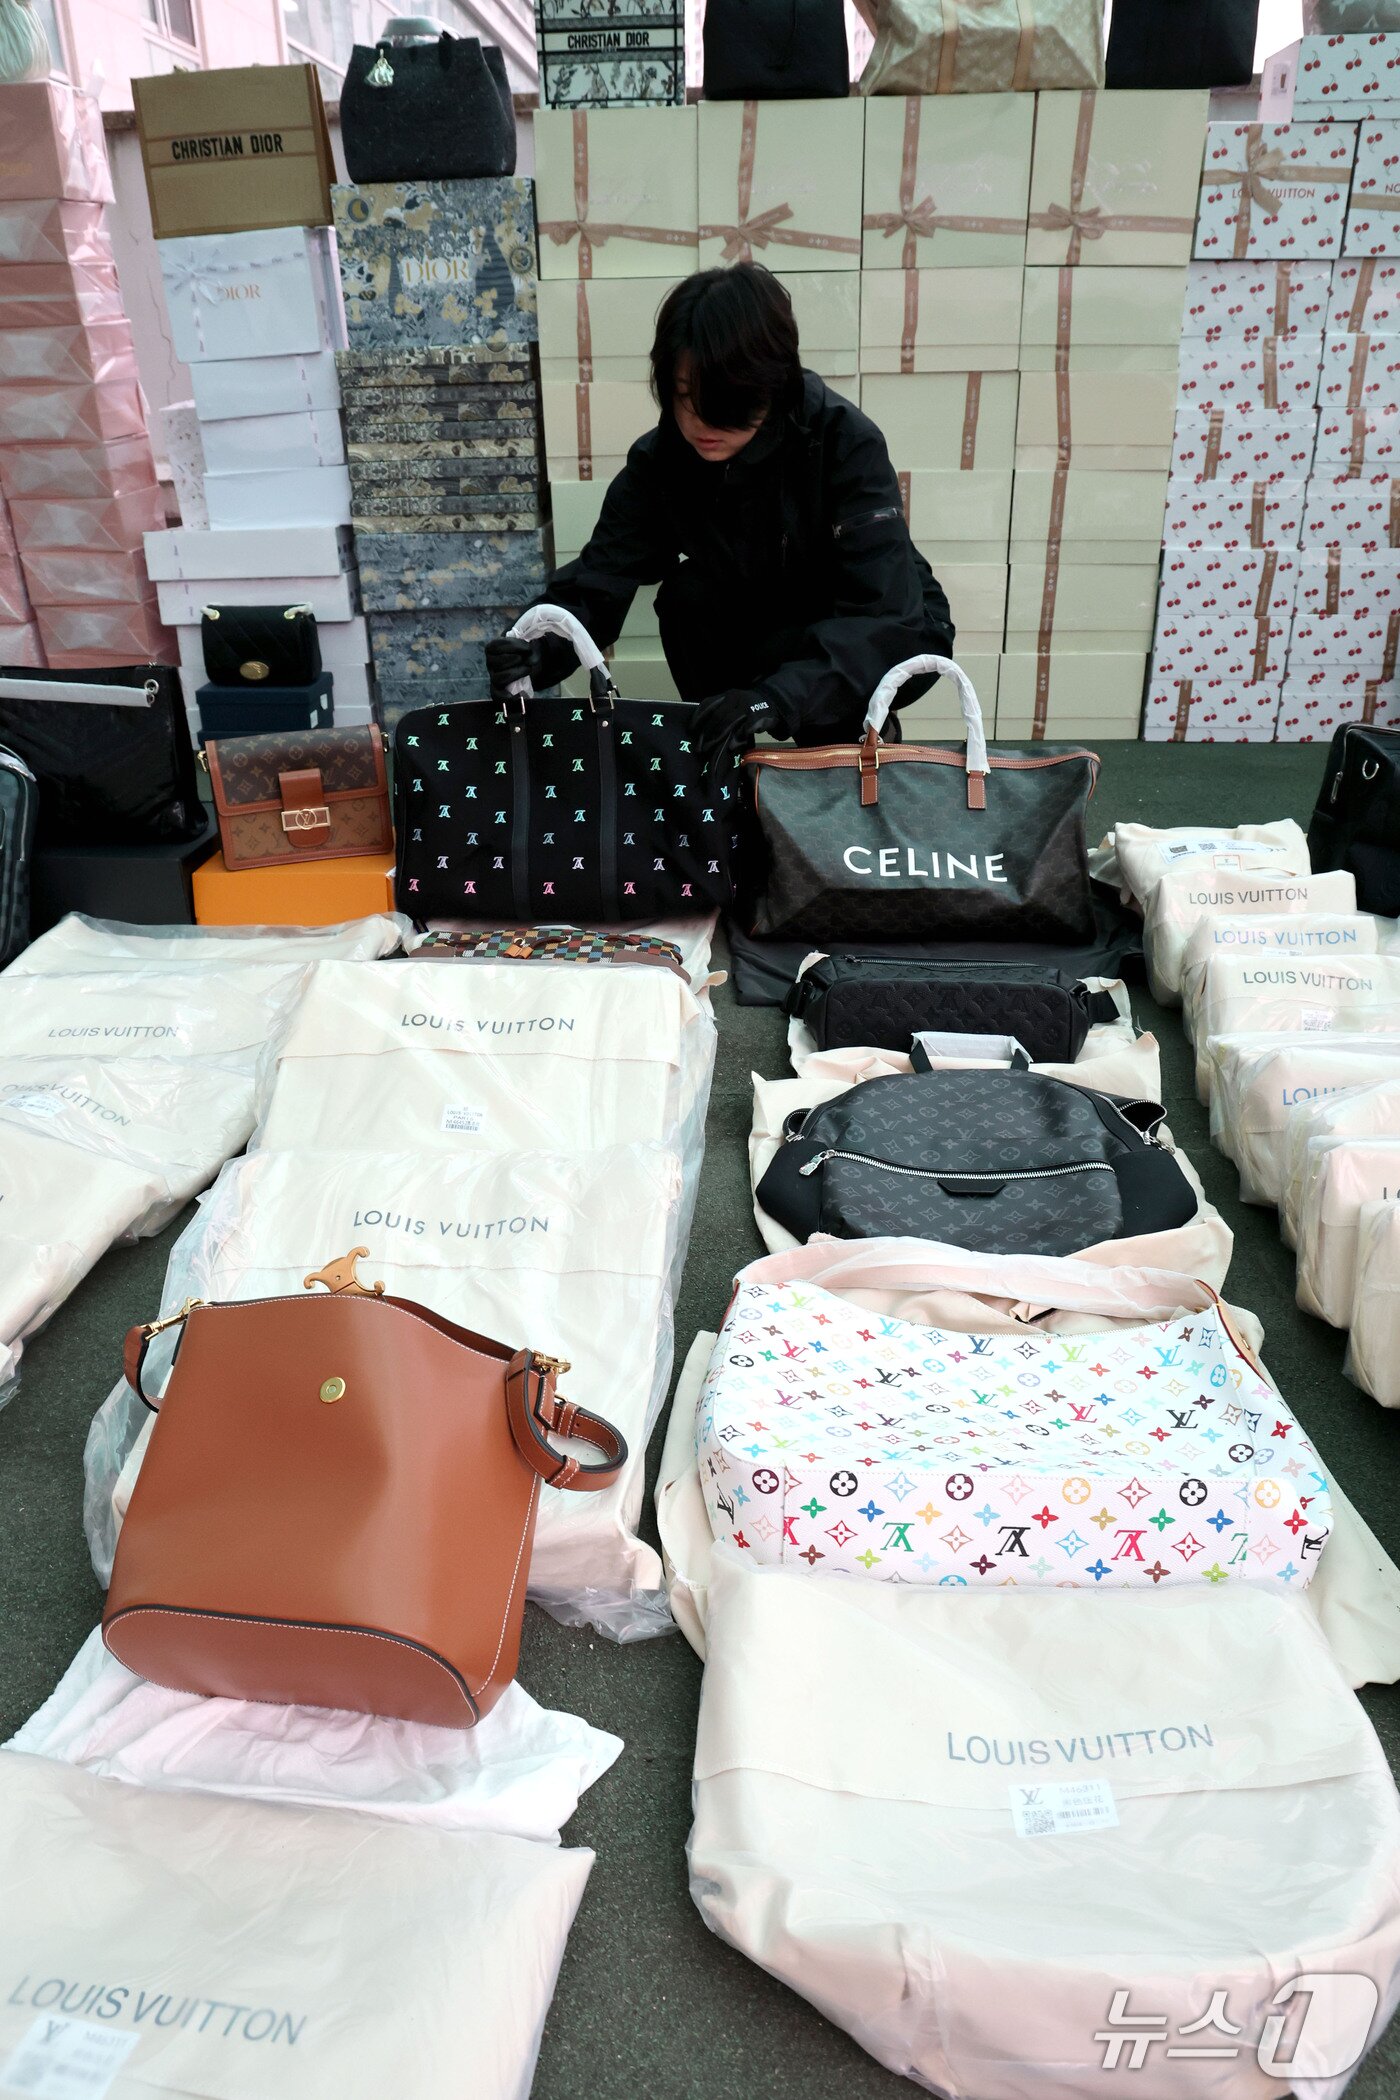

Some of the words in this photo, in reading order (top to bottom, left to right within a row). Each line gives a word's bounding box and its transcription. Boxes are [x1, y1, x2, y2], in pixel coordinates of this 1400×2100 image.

[568, 33, 620, 49] CHRISTIAN
[626, 31, 649, 46] DIOR
[171, 136, 244, 160] CHRISTIAN
[250, 133, 283, 154] DIOR
[405, 258, 469, 282] DIOR
[750, 701, 770, 712] POLICE
[843, 846, 1008, 882] CELINE
[1189, 892, 1235, 905] LOUIS
[1237, 888, 1309, 904] VUITTON
[1213, 930, 1267, 945] LOUIS
[1274, 929, 1357, 946] VUITTON
[1243, 971, 1297, 985] LOUIS
[1299, 971, 1373, 991] VUITTON
[48, 1027, 101, 1038] LOUIS
[104, 1026, 179, 1038] VUITTON
[401, 1013, 466, 1032] LOUIS
[477, 1017, 575, 1035] VUITTON
[51, 1083, 131, 1127] VUITTON
[353, 1210, 426, 1235] LOUIS
[439, 1216, 550, 1239] VUITTON
[947, 1731, 1051, 1766] LOUIS
[1055, 1723, 1215, 1764] VUITTON
[8, 1975, 130, 2020] LOUIS
[132, 1990, 308, 2046] VUITTON
